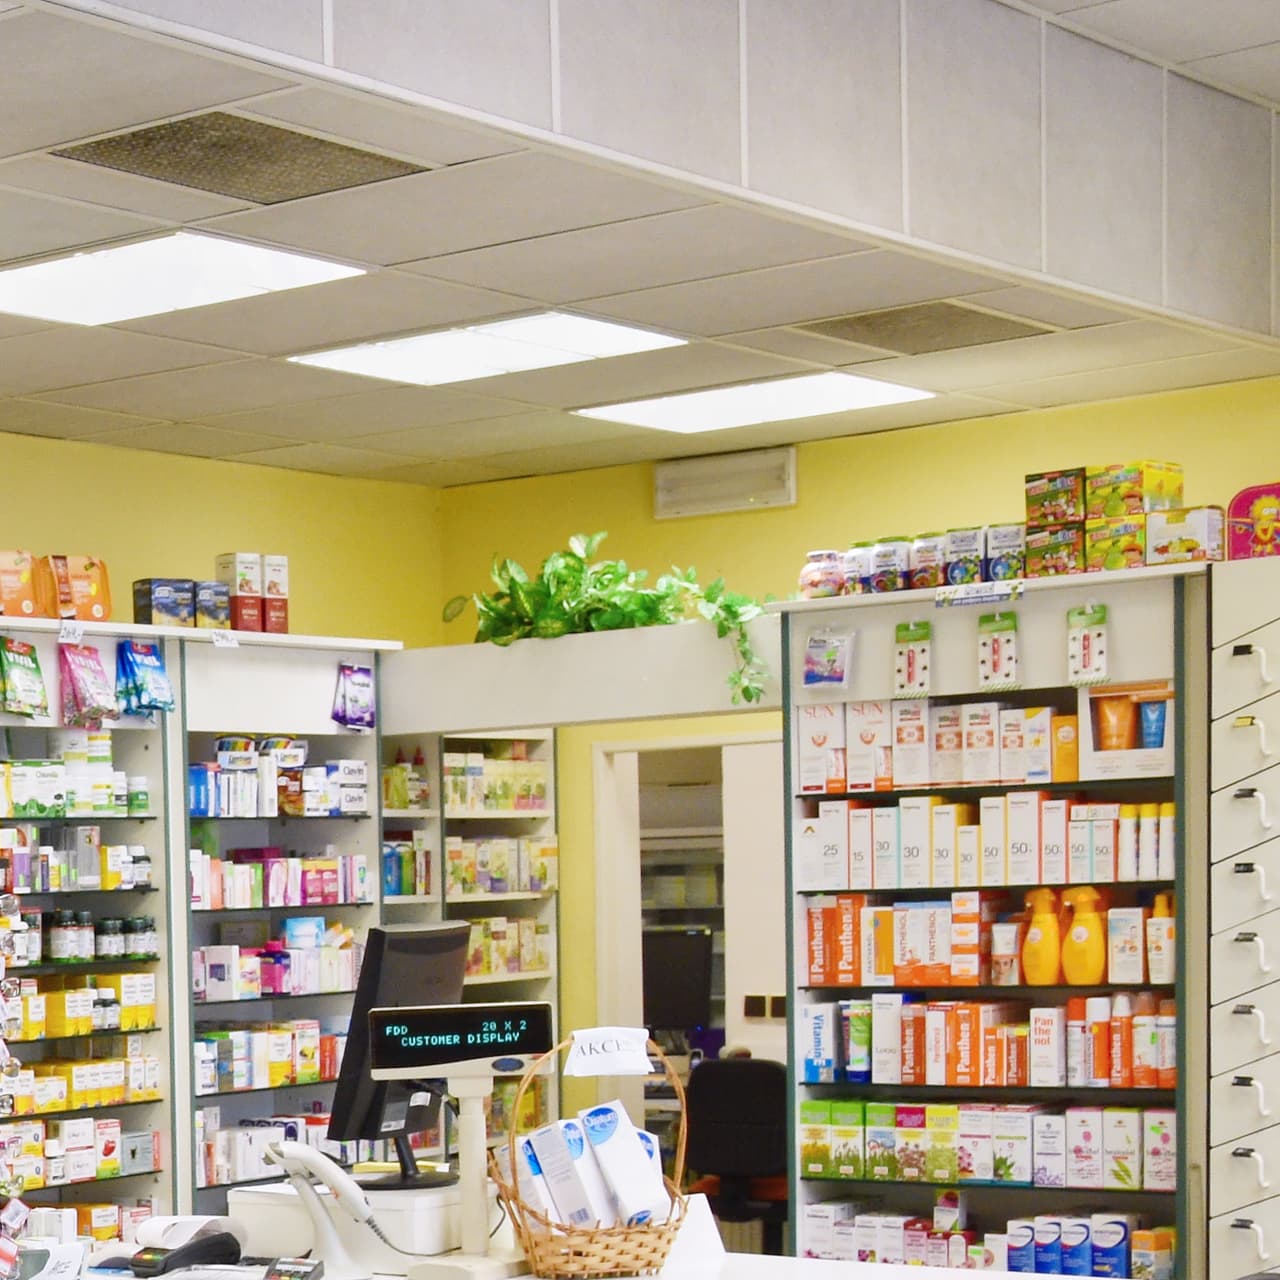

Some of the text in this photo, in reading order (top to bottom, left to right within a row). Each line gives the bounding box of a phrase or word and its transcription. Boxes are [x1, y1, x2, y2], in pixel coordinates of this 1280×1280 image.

[824, 845, 837, 856] 25
[386, 1025, 408, 1036] FDD
[519, 1020, 527, 1030] 2
[401, 1032, 520, 1047] CUSTOMER DISPLAY
